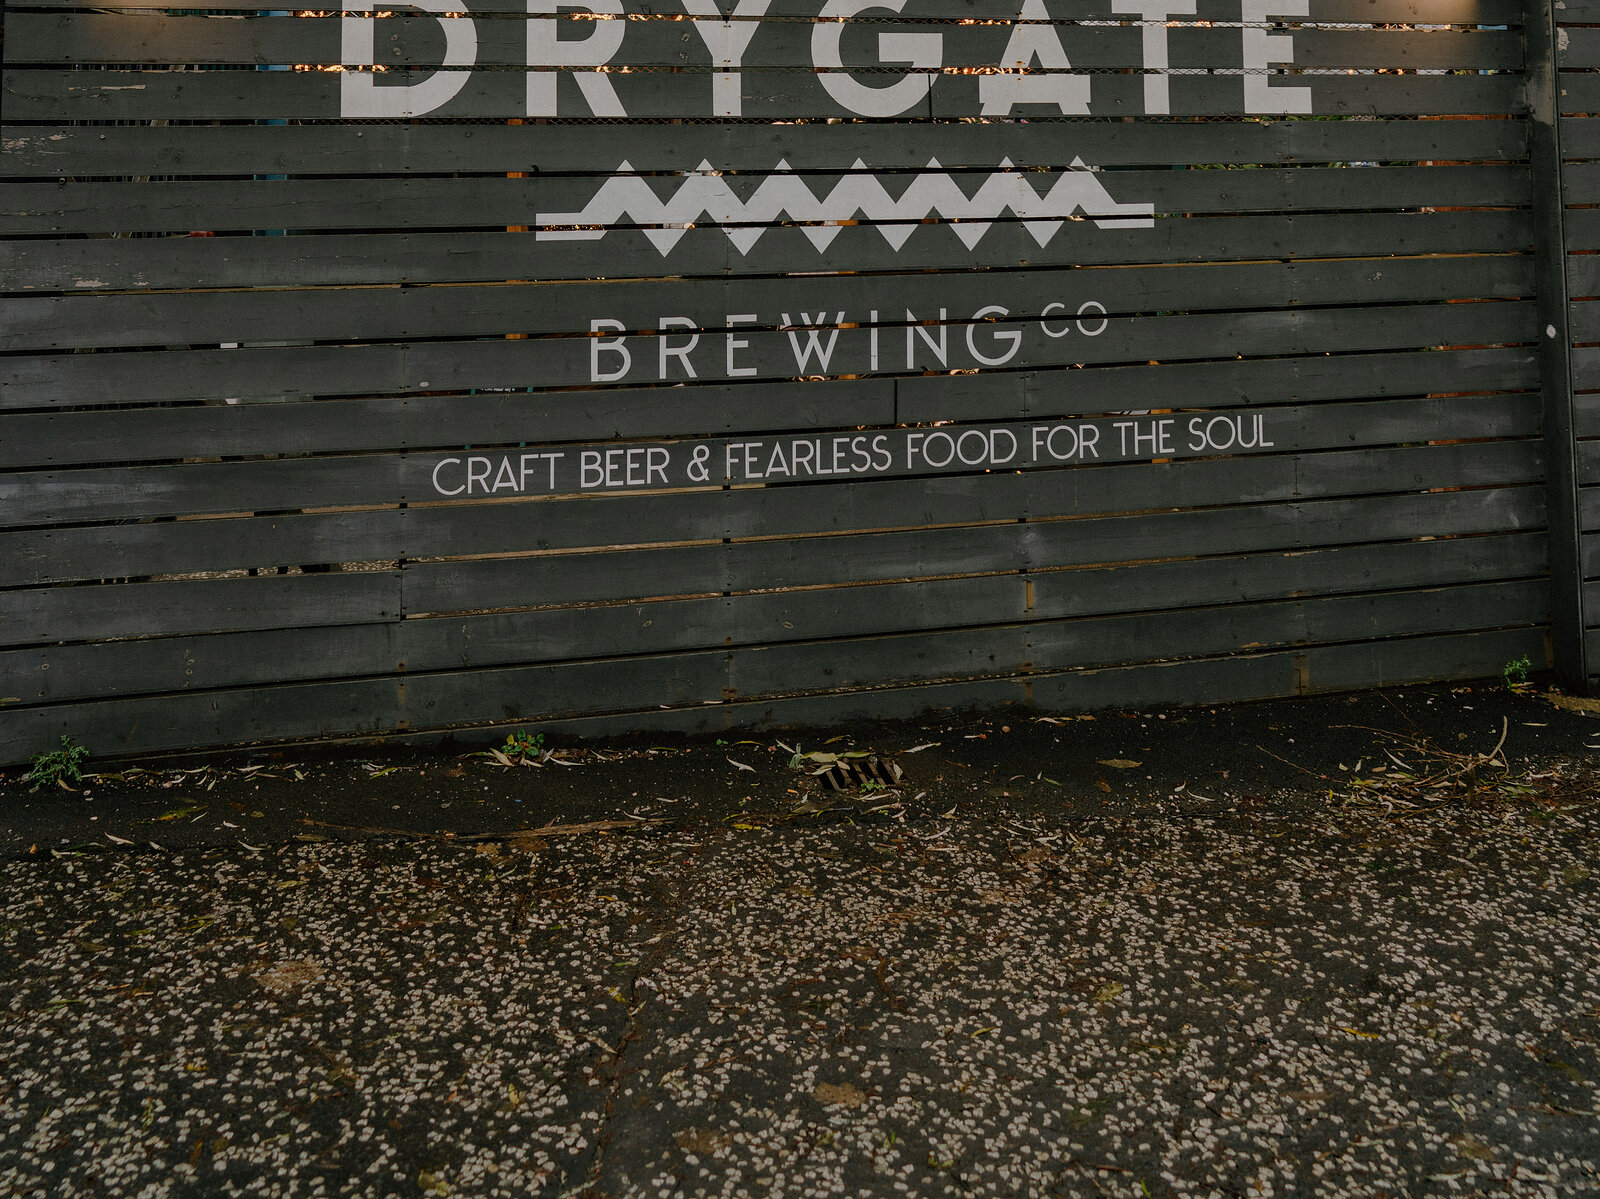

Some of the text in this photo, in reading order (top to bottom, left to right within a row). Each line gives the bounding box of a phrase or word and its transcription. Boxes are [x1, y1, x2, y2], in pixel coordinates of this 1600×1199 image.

[590, 301, 1108, 382] BREWING CO
[432, 414, 1274, 495] CRAFT BEER & FEARLESS FOOD FOR THE SOUL
